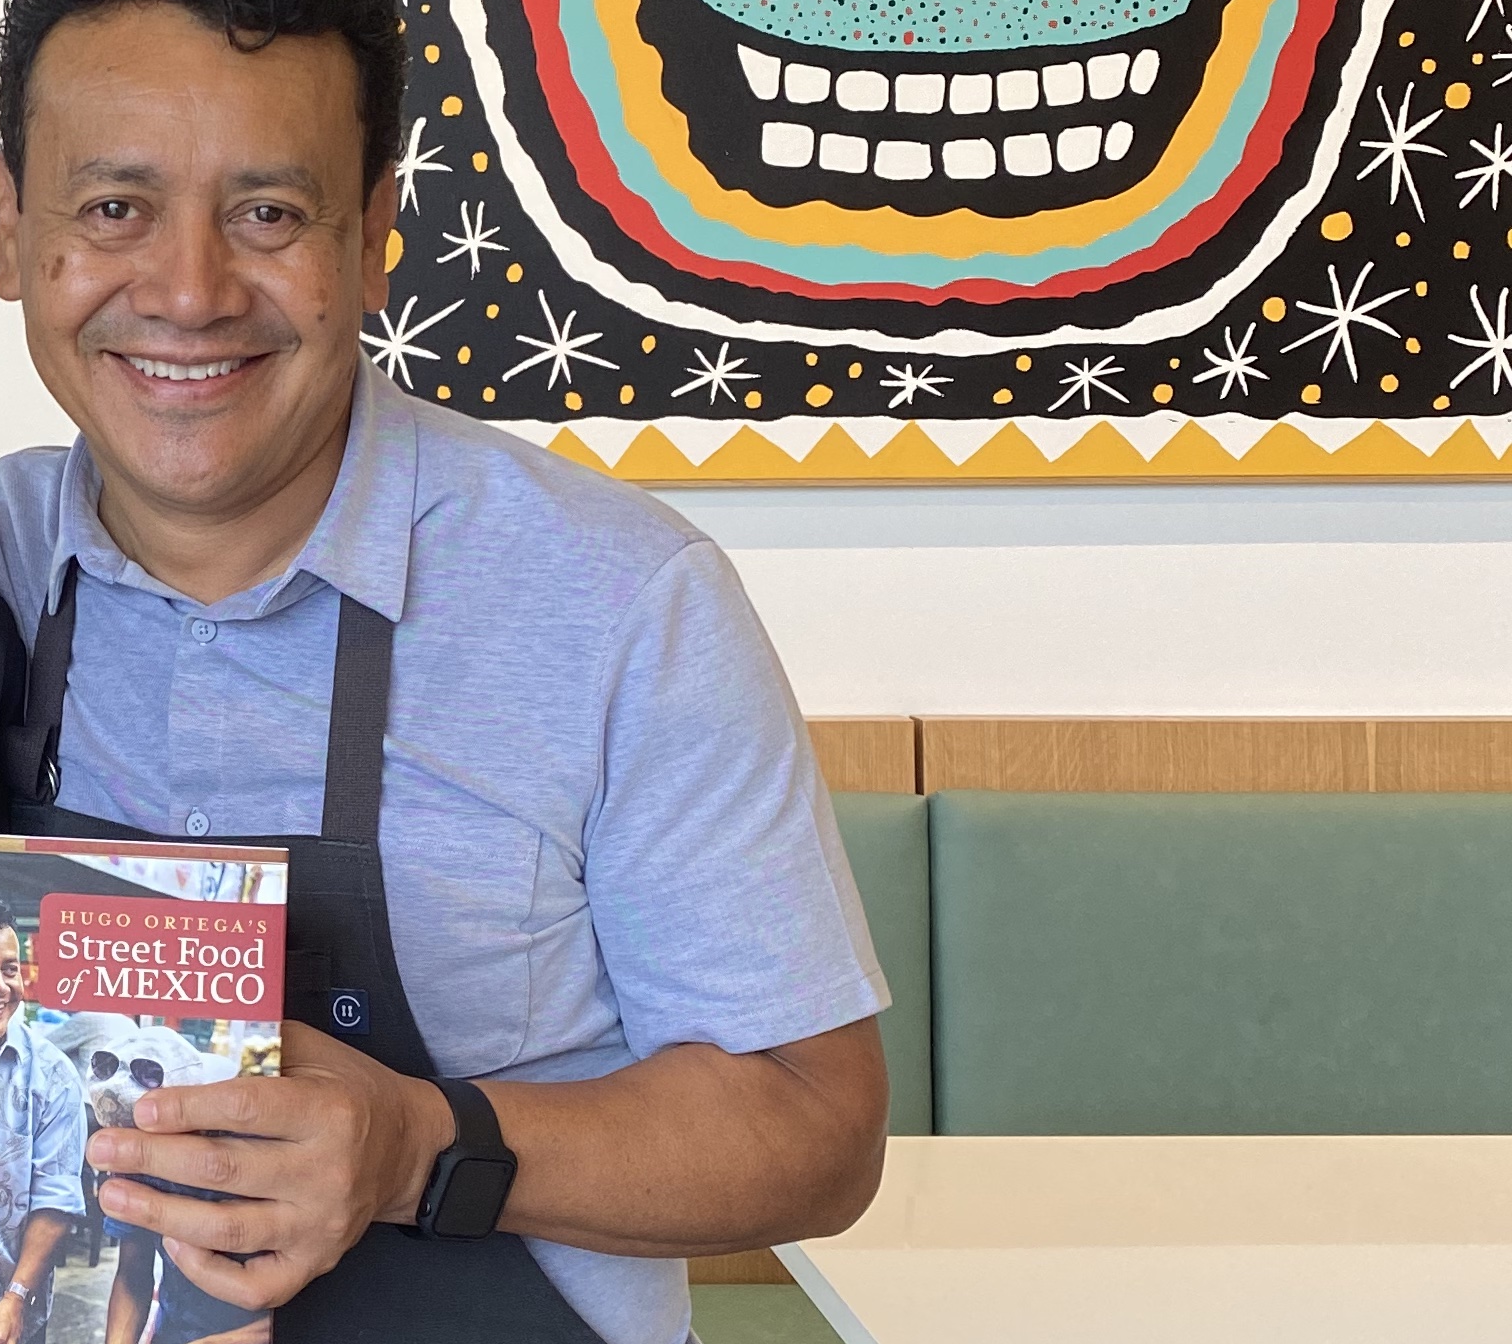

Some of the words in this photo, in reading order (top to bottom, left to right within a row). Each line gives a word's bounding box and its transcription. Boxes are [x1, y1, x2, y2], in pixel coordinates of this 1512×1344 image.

[60, 910, 131, 928] HUGO
[144, 914, 267, 934] ORTEGA'S
[58, 931, 167, 964] Street
[176, 936, 265, 969] Food
[56, 969, 91, 1005] of
[93, 965, 265, 1005] MEXICO
